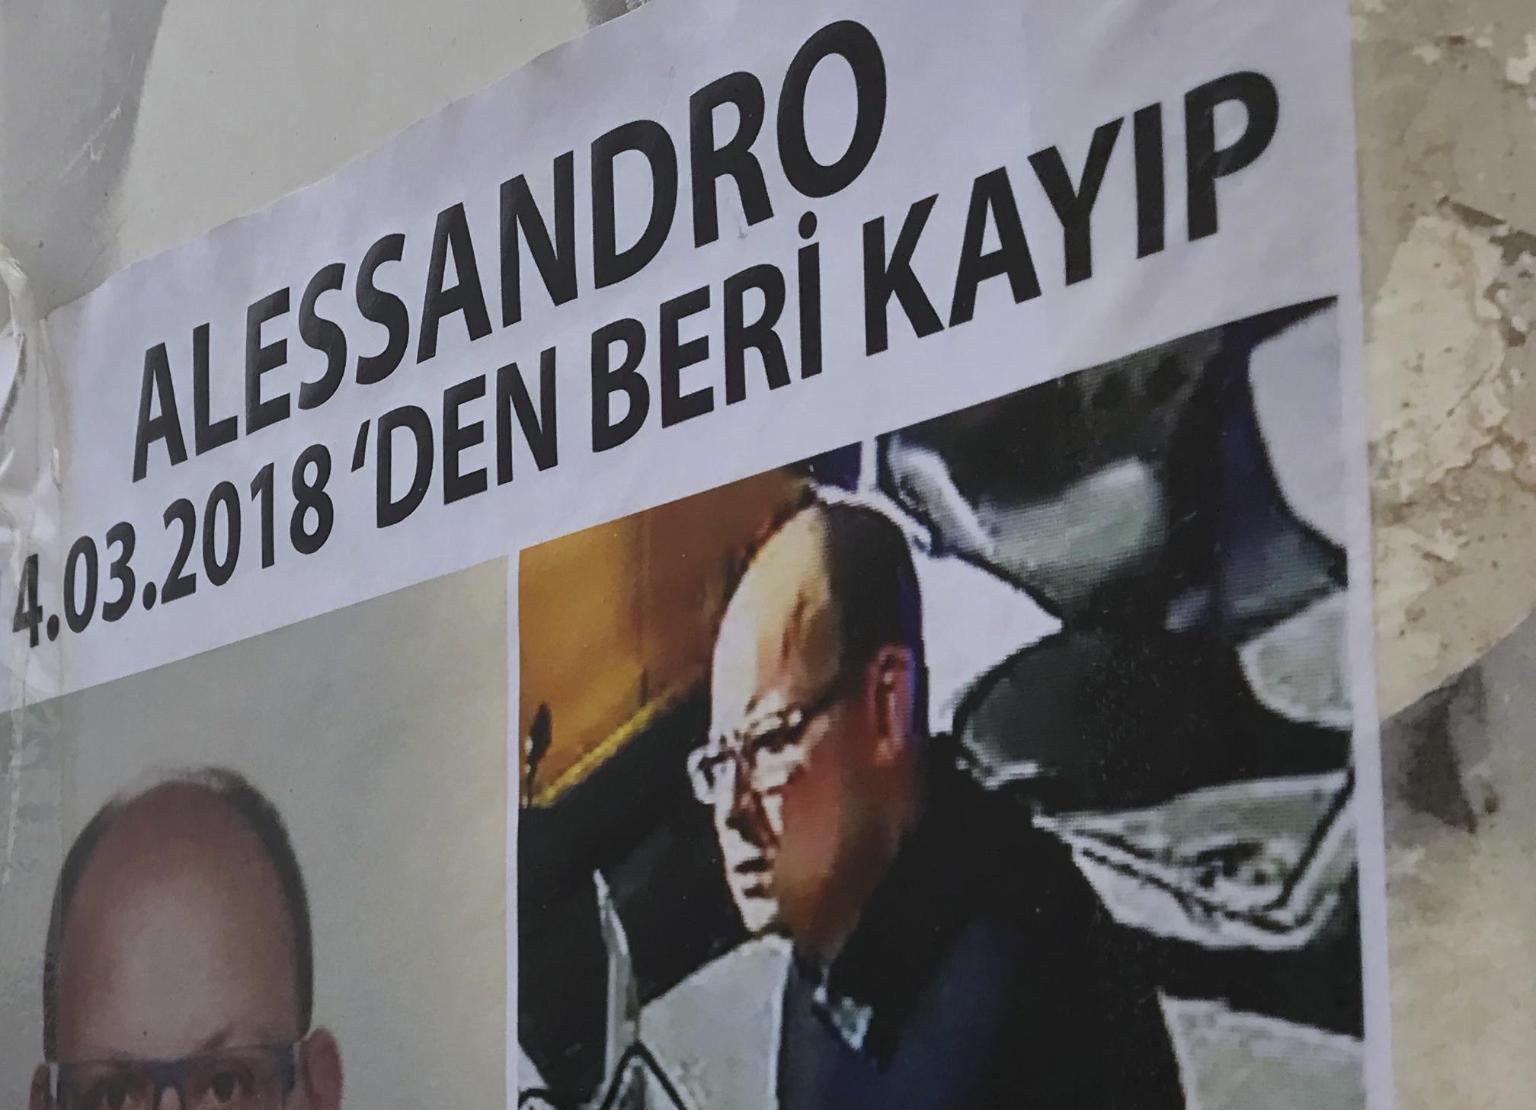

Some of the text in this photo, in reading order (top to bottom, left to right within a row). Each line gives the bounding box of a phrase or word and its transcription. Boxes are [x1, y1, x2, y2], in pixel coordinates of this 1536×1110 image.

[133, 20, 887, 483] ALESSANDRO
[591, 210, 822, 452] BERİ
[863, 71, 1279, 357] KAYIP
